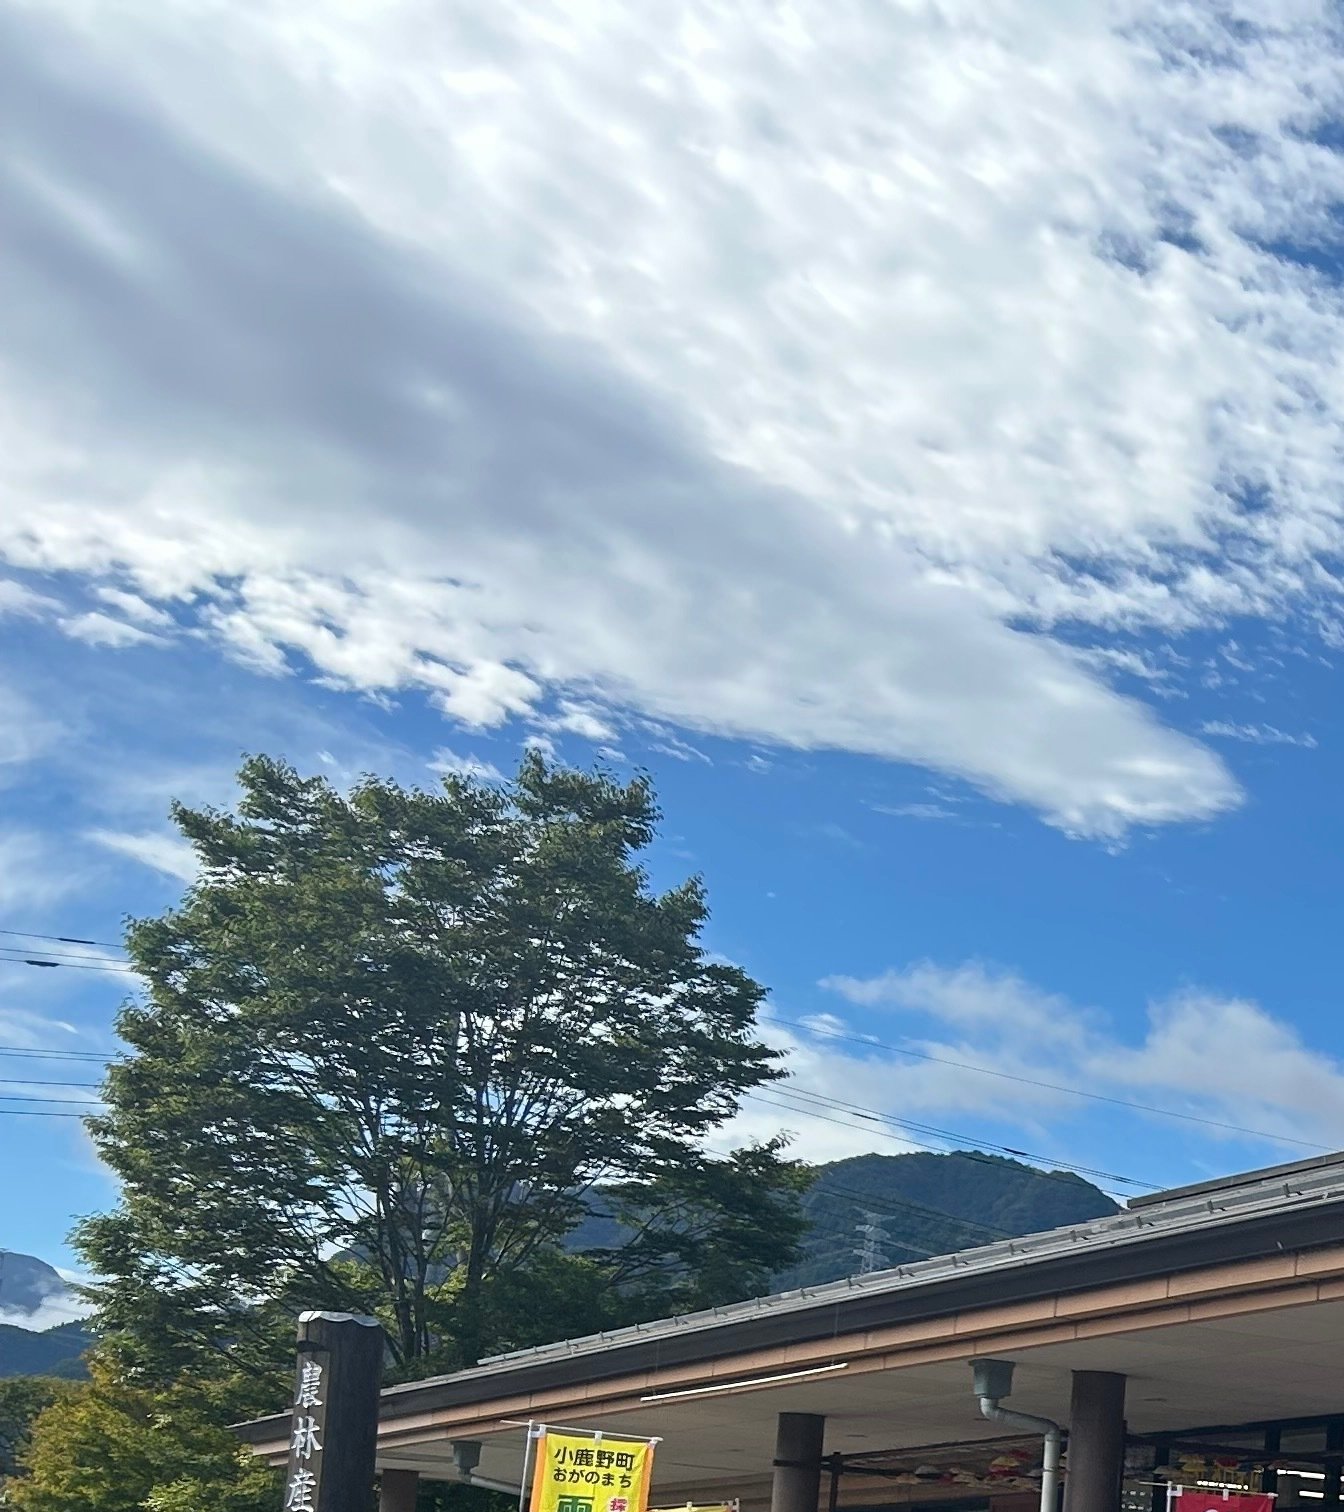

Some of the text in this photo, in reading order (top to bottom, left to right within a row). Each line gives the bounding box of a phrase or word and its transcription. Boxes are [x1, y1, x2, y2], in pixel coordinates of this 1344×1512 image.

[554, 1446, 635, 1472] 小鹿野町
[553, 1467, 632, 1489] おがのまち
